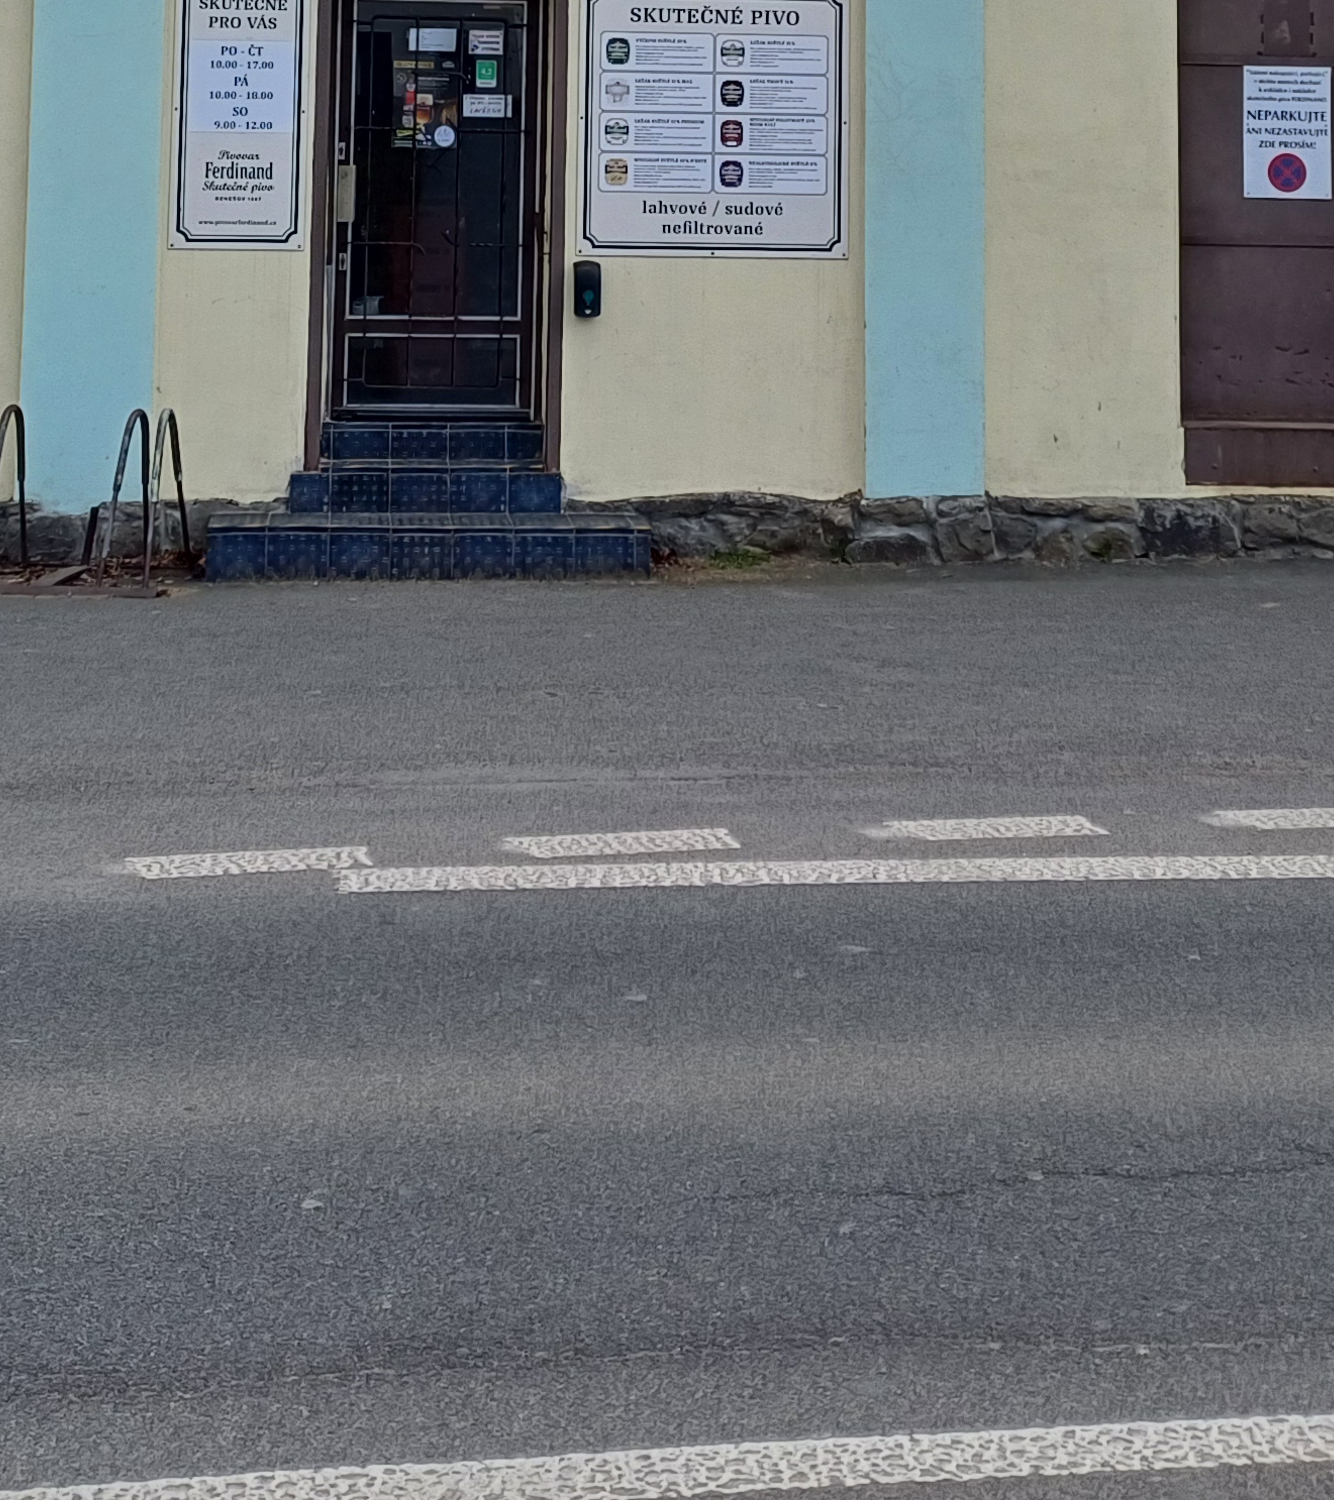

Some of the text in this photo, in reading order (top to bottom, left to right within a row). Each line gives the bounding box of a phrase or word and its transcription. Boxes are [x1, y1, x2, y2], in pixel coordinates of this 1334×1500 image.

[208, 14, 277, 29] PRO VÁS
[630, 5, 800, 26] SKUTEČNÉ PIVO
[221, 46, 237, 56] PO
[248, 44, 264, 56] ČT
[210, 60, 237, 69] 10.00
[247, 61, 274, 69] 17.00
[234, 74, 248, 87] PÁ
[209, 91, 237, 100] 10.00
[246, 91, 273, 100] 18.00
[232, 106, 248, 117] SO
[1247, 109, 1327, 124] NEPARKUJTE
[214, 121, 236, 129] 9.00
[245, 121, 273, 130] 12.00
[1246, 127, 1329, 137] ANI NEZASTAVUJTE
[1258, 140, 1276, 148] ZDE
[218, 149, 260, 160] Pivovar
[205, 161, 273, 180] Ferdinand
[202, 181, 275, 194] Skutečné pivo
[642, 200, 783, 217] lahvové / sudové
[662, 220, 763, 235] nefiltrované
